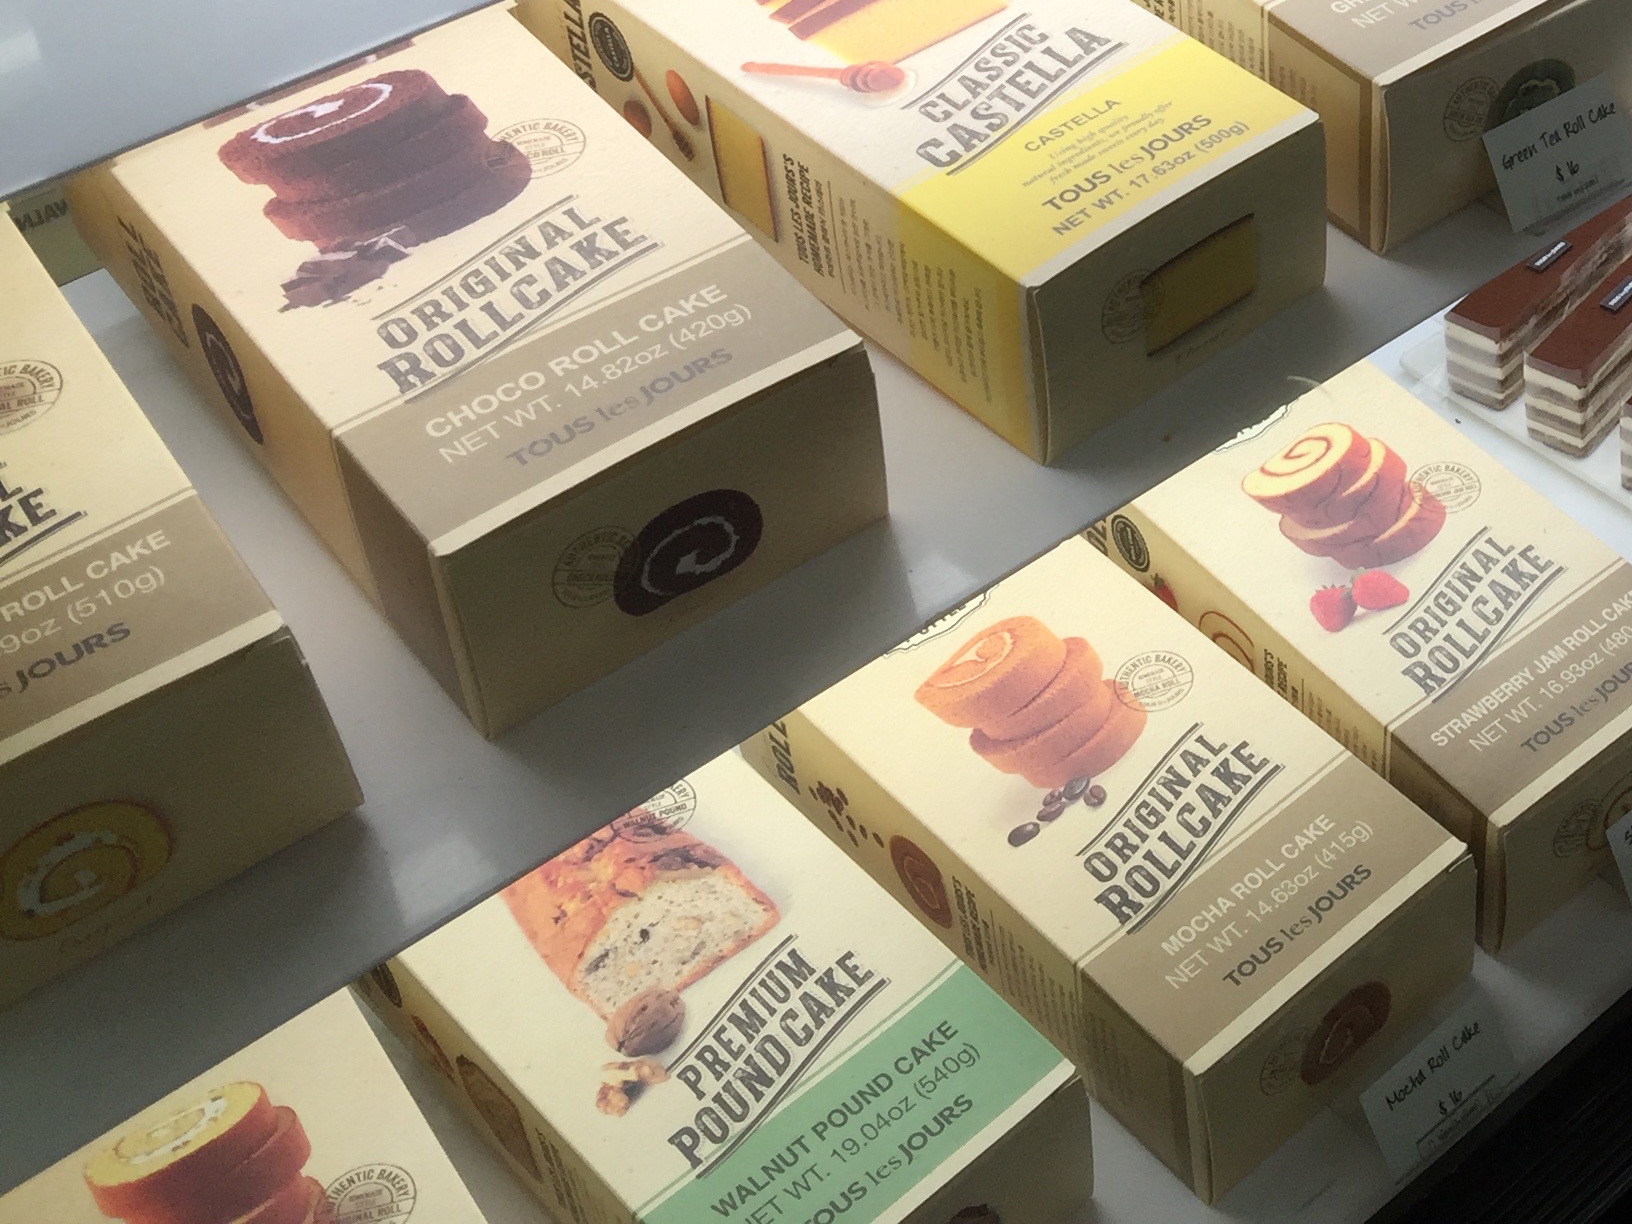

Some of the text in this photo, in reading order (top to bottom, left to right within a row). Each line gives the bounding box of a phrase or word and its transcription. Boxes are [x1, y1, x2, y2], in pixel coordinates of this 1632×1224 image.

[1351, 1, 1396, 29] NET
[1409, 0, 1469, 31] TOUS
[915, 25, 1113, 170] CASTELLA
[918, 21, 1050, 125] CLASSIC
[543, 122, 579, 143] BAKERY
[1024, 98, 1122, 153] CASTELLA
[1041, 114, 1213, 212] TOUS les JOURS
[1073, 154, 1097, 170] made
[1075, 130, 1097, 147] high
[1502, 102, 1617, 170] Green Tea Roll Cake
[1555, 160, 1580, 182] $ 16
[783, 153, 808, 265] TOUS LES JOURS'S
[797, 161, 824, 277] HOMEMADE RECIPE
[1051, 120, 1250, 236] NET WT. 17.63oz (500g)
[376, 207, 602, 351] ORIGINAL
[377, 216, 648, 396] ROLLCAKE
[19, 363, 55, 390] BAKERY
[425, 284, 728, 438] CHOCO ROLL CAKE
[438, 303, 753, 464] NET WT. 14.82oz (420g)
[506, 347, 734, 467] TOUS les JOURS
[1444, 464, 1473, 483] BAKERY
[1, 529, 172, 624] ROLL CAKE
[67, 565, 167, 626] (510g)
[1389, 536, 1516, 659] ORIGINAL
[1401, 544, 1555, 697] ROLLCAKE
[16, 621, 132, 695] JOURS
[1154, 654, 1186, 673] BAKERY
[1430, 666, 1535, 748] STRAWBERRY
[1532, 644, 1568, 675] JAM
[1563, 616, 1608, 651] ROLL
[1468, 718, 1510, 753] NET
[1504, 695, 1543, 727] WT.
[1539, 651, 1605, 701] 16.93oz
[1520, 711, 1576, 754] TOUS
[1570, 696, 1599, 719] les
[659, 803, 688, 818] POUND
[1083, 734, 1228, 883] ORIGINAL
[1094, 740, 1270, 926] ROLLCAKE
[1161, 813, 1337, 956] MOCHA ROLL CAKE
[1164, 819, 1375, 990] NET WT. 14.63oz (415g)
[1222, 864, 1373, 987] TOUS les JOURS
[676, 947, 817, 1101] PREMIUM
[1386, 1022, 1480, 1111] Mocha Roll Cake
[710, 1020, 960, 1218] WALNUT POUND CAKE
[782, 1042, 982, 1204] WT. 19.04oz (540g)
[864, 1092, 974, 1188] les JOURS
[376, 1168, 410, 1198] BAKERY
